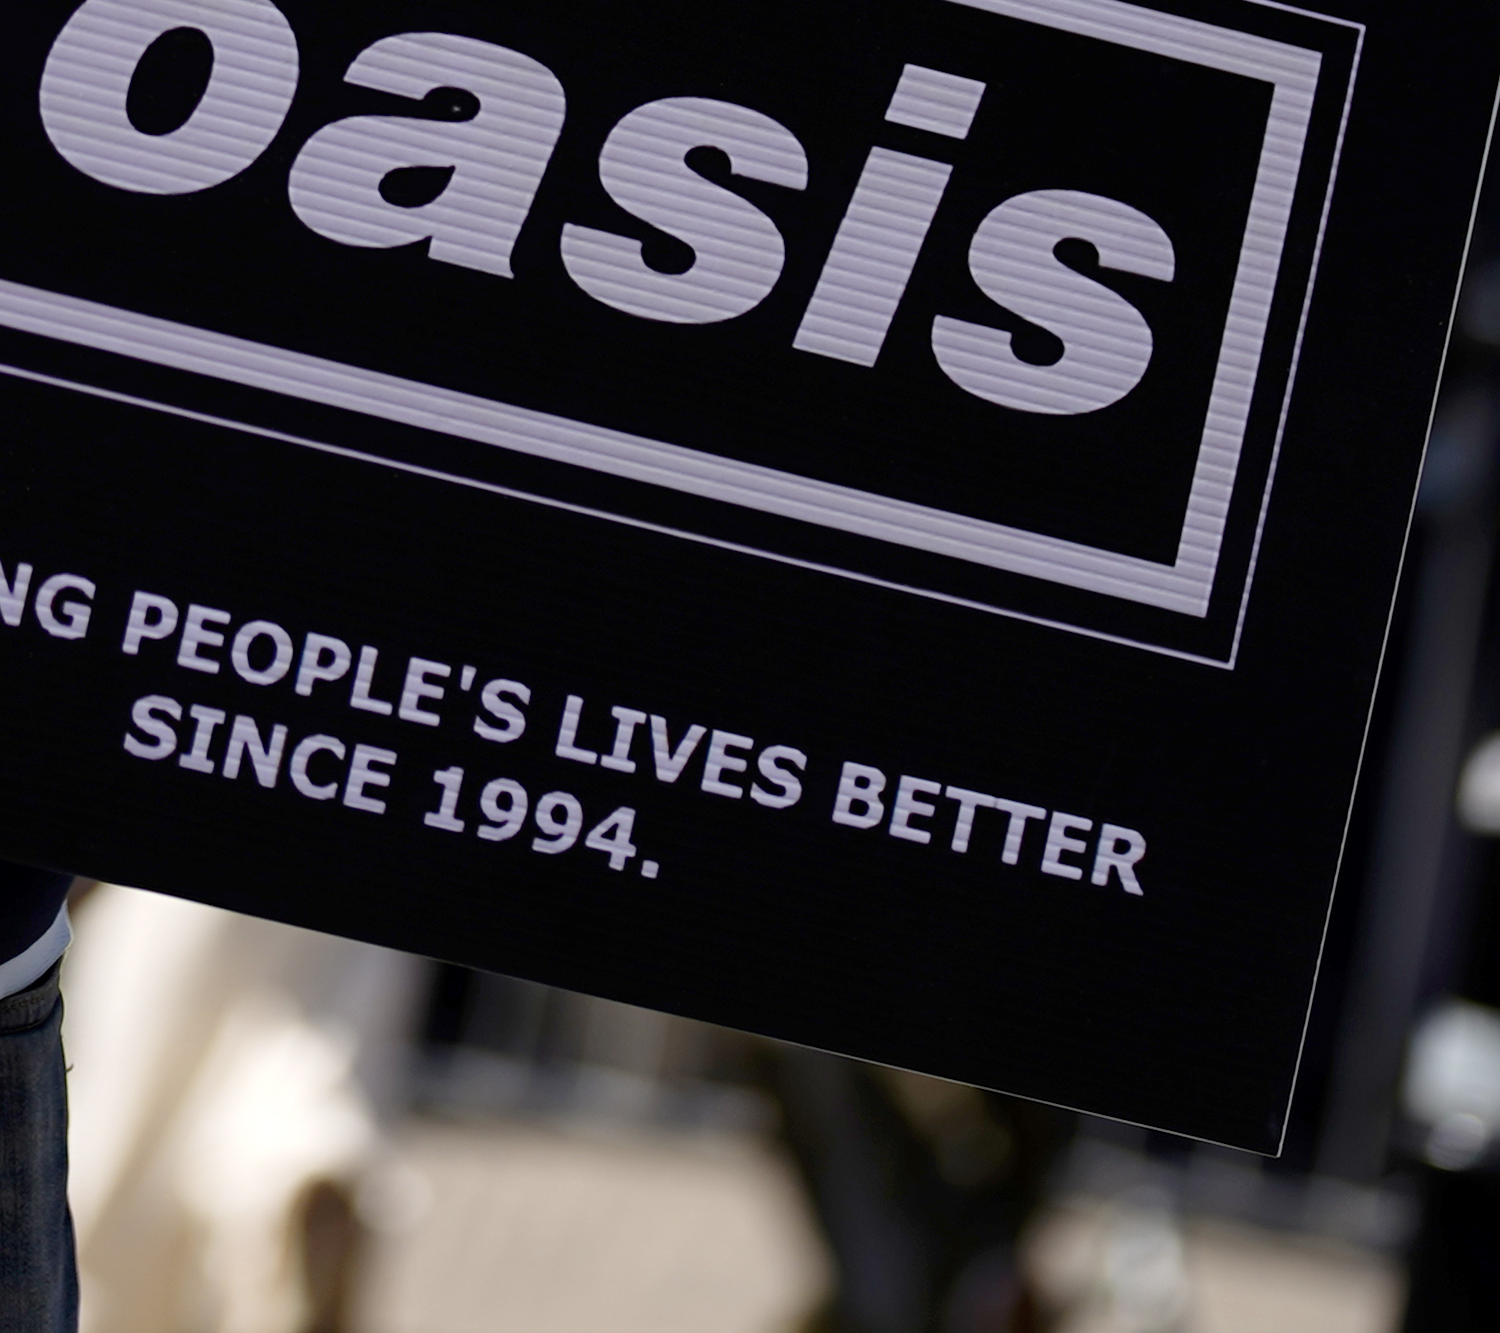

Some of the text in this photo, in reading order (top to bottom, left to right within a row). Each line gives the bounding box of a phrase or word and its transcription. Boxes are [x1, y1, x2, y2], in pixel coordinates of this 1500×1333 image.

[121, 590, 532, 743] PEOPLE'S
[555, 694, 808, 809] LIVES
[831, 761, 1147, 896] BETTER
[123, 694, 661, 880] SINCE 1994.
